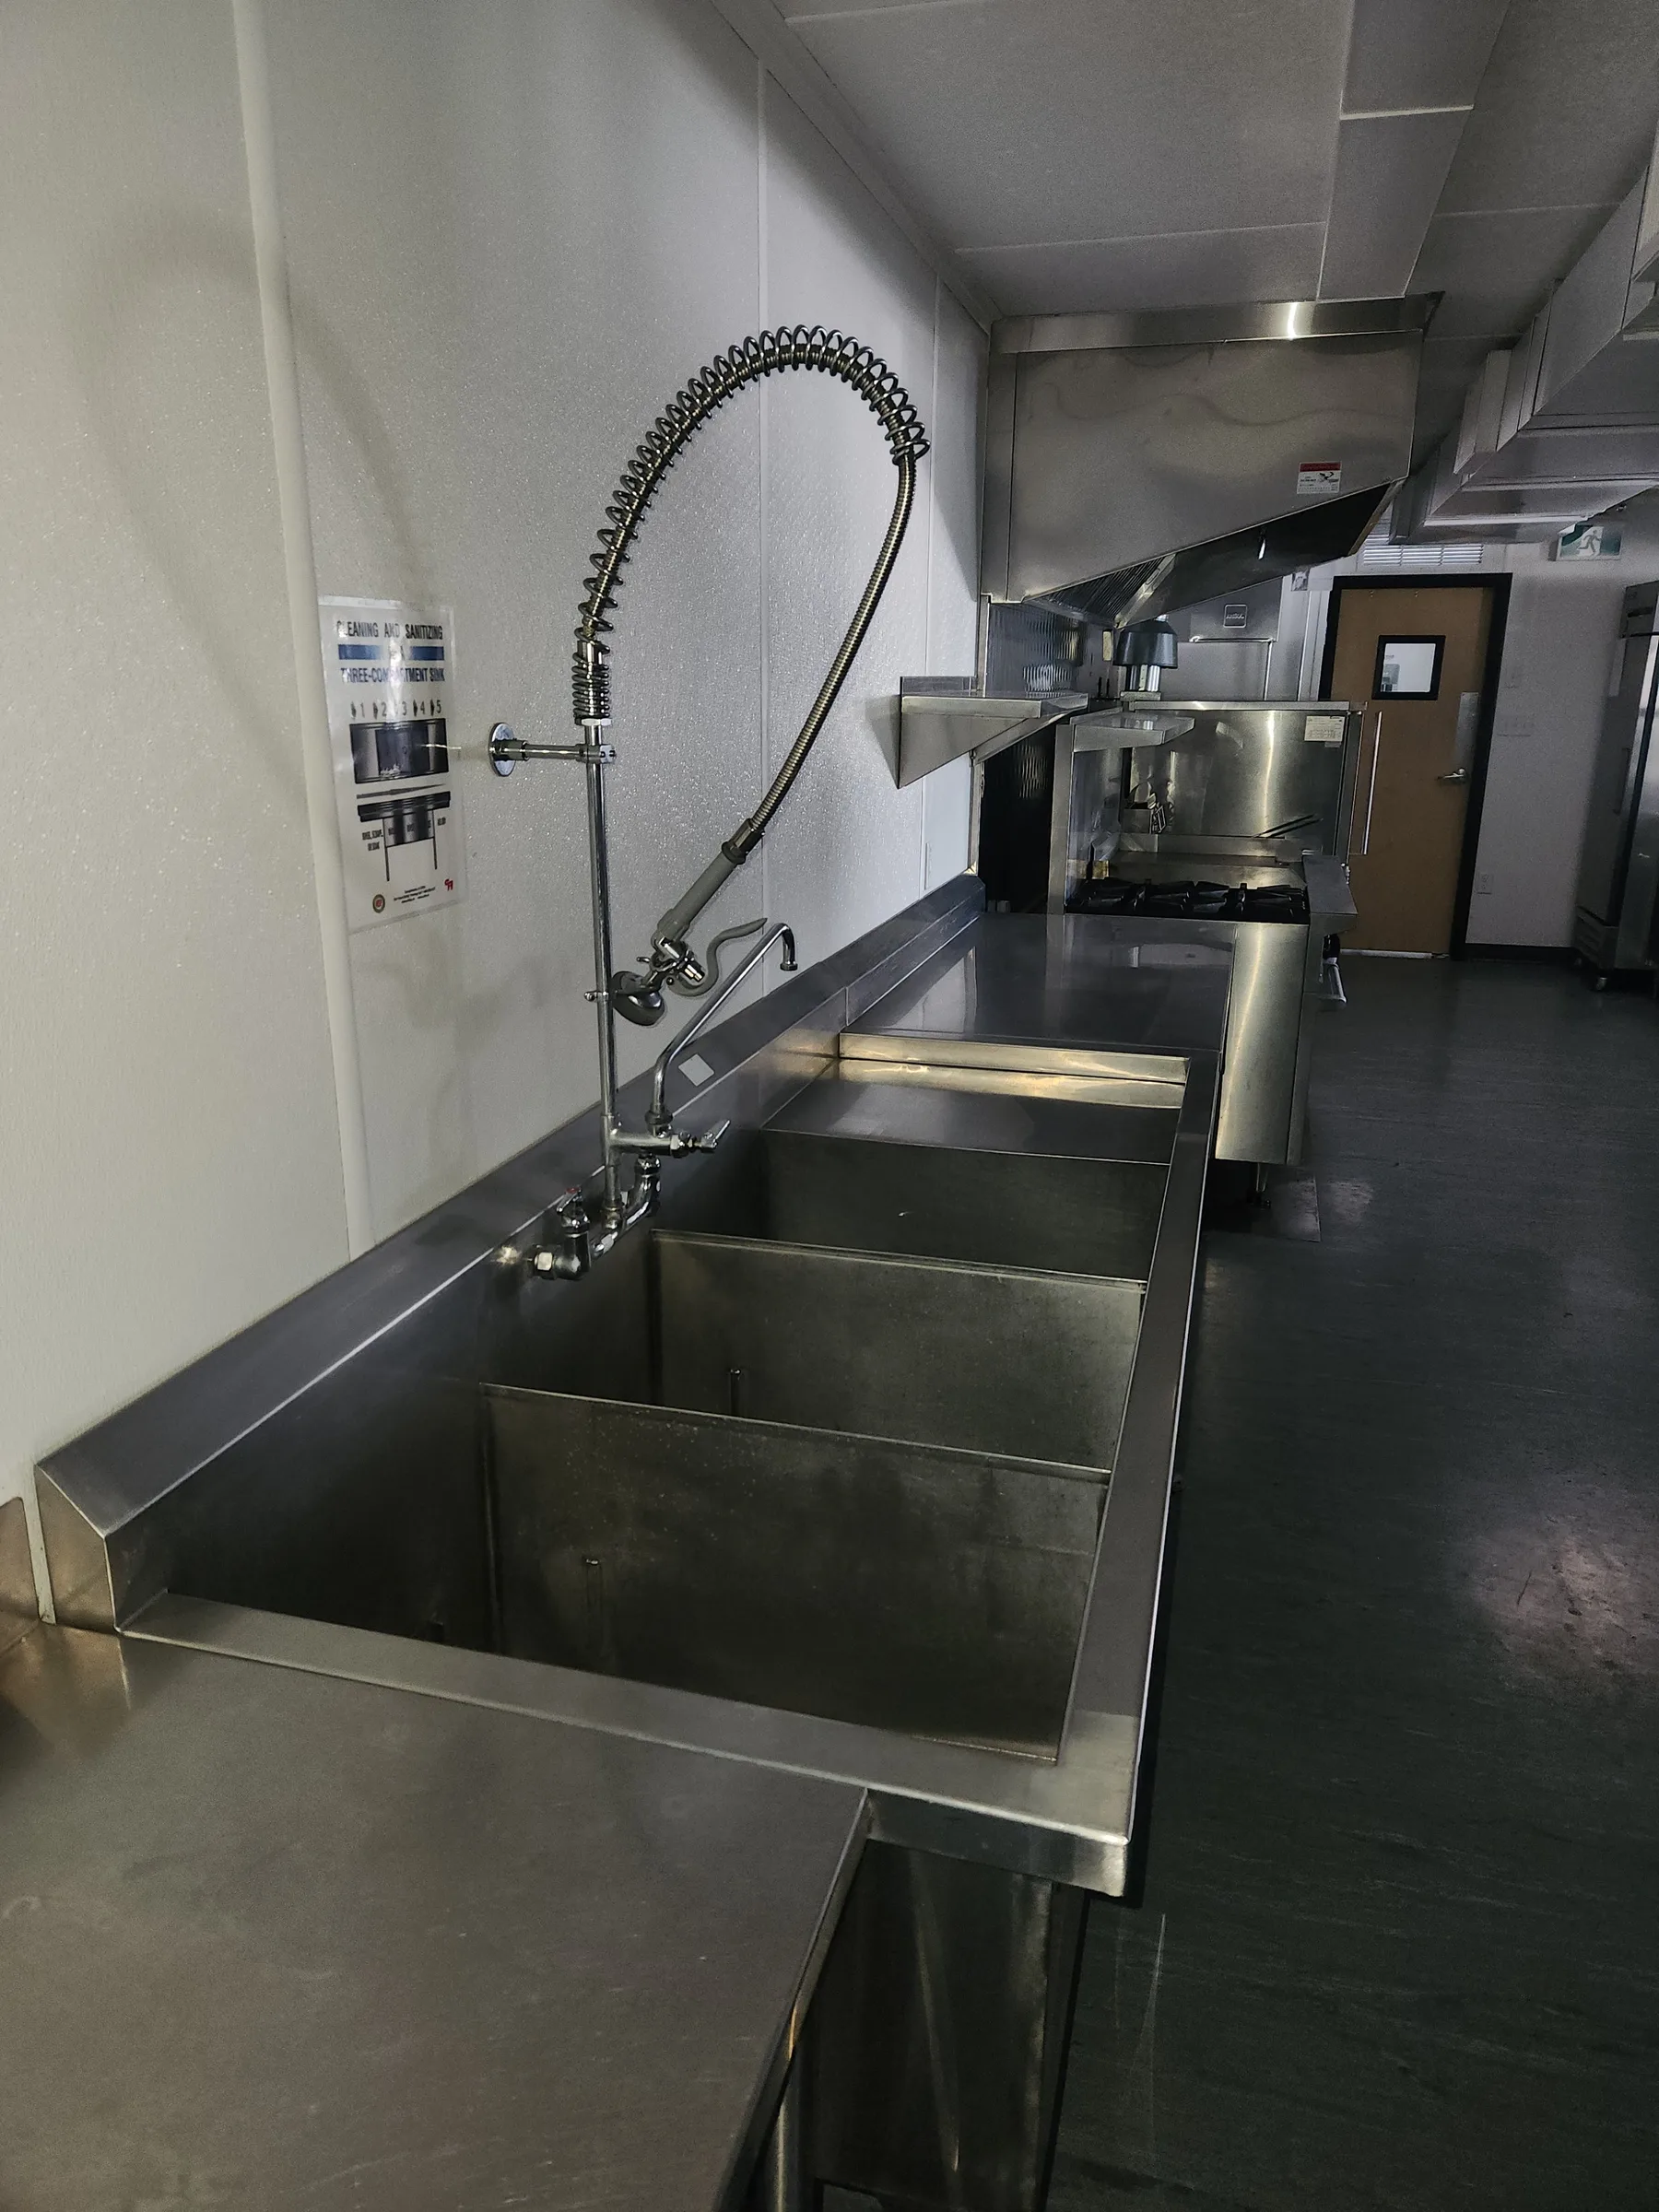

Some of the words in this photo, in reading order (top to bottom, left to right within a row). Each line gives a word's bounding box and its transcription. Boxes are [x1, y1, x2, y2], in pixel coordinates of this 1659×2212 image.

[336, 620, 379, 638] CEANING
[384, 622, 400, 638] AND
[406, 623, 443, 640] SANITIZING
[429, 667, 445, 682] SINK
[381, 701, 387, 717] 2
[402, 701, 407, 716] 3
[420, 701, 426, 715] 4
[436, 700, 442, 713] 5
